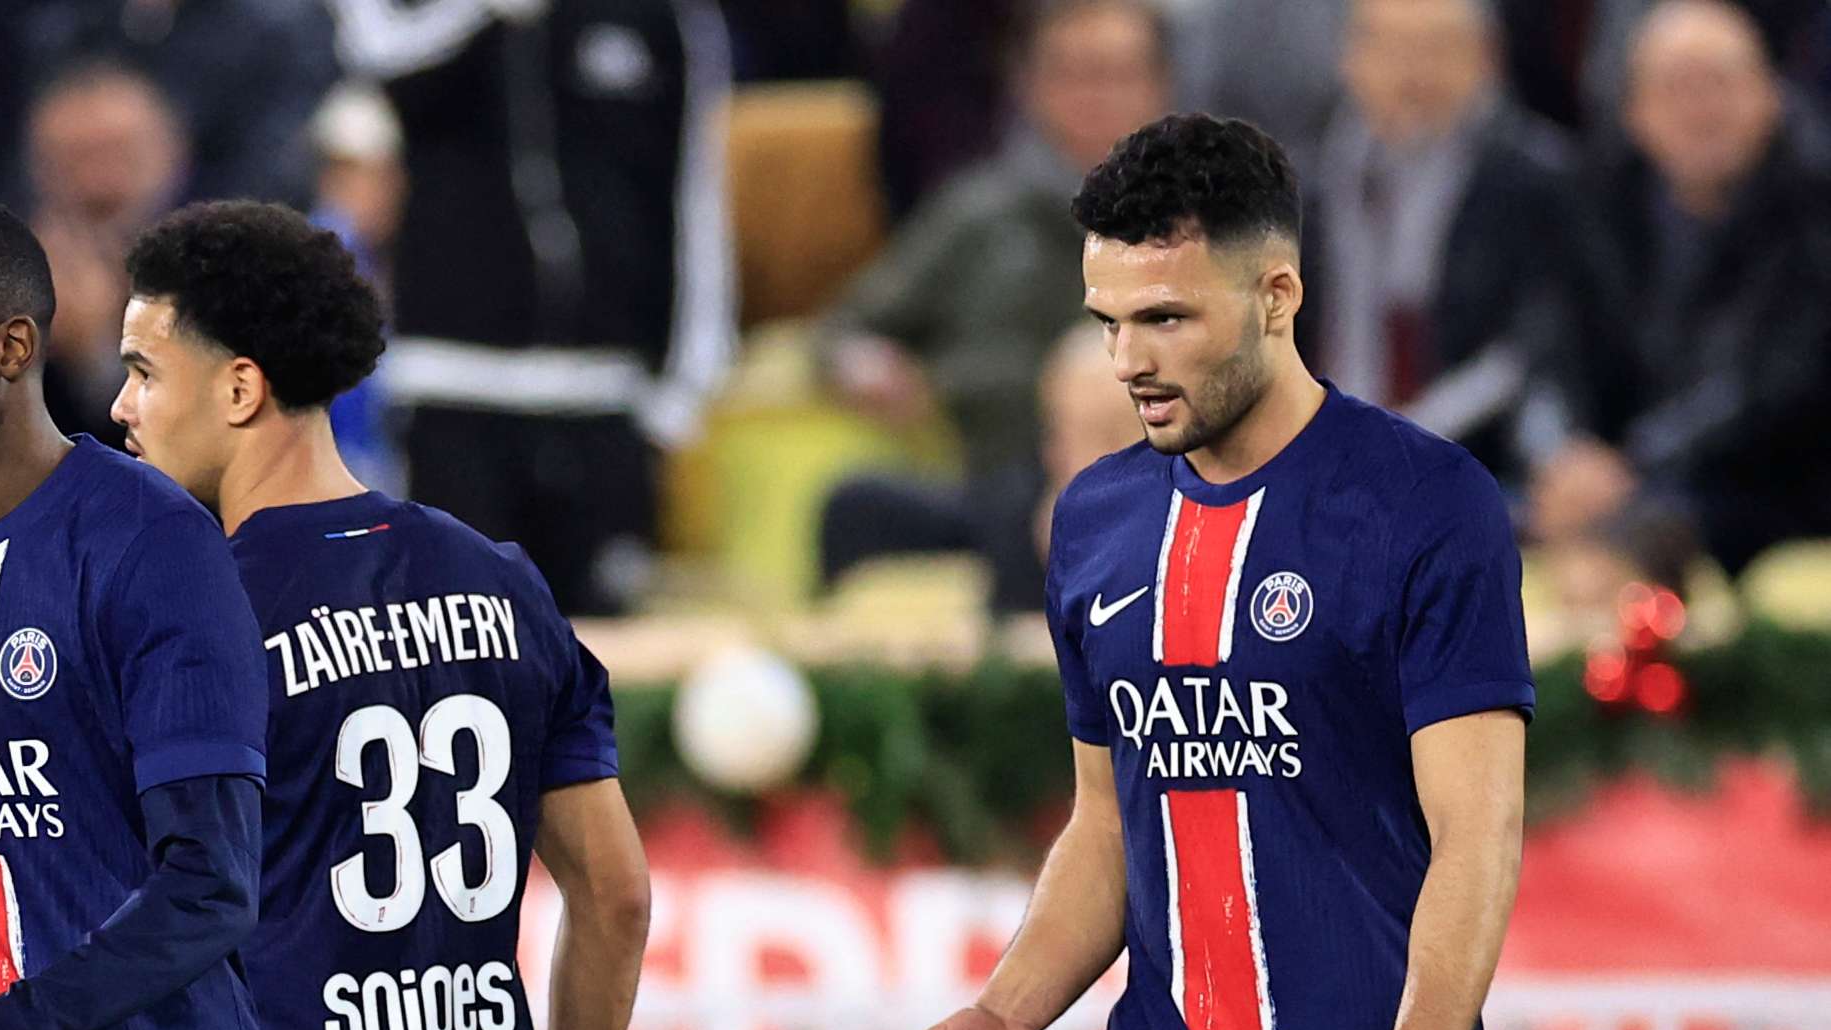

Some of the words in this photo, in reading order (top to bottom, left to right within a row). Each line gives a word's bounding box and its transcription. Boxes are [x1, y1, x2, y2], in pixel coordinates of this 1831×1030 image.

[1265, 575, 1305, 595] PARIS
[10, 631, 49, 650] PARIS
[264, 594, 519, 697] ZAÏRE-EMERY
[1109, 677, 1299, 751] QATAR
[1146, 740, 1302, 778] AIRWAYS
[330, 694, 518, 932] 33
